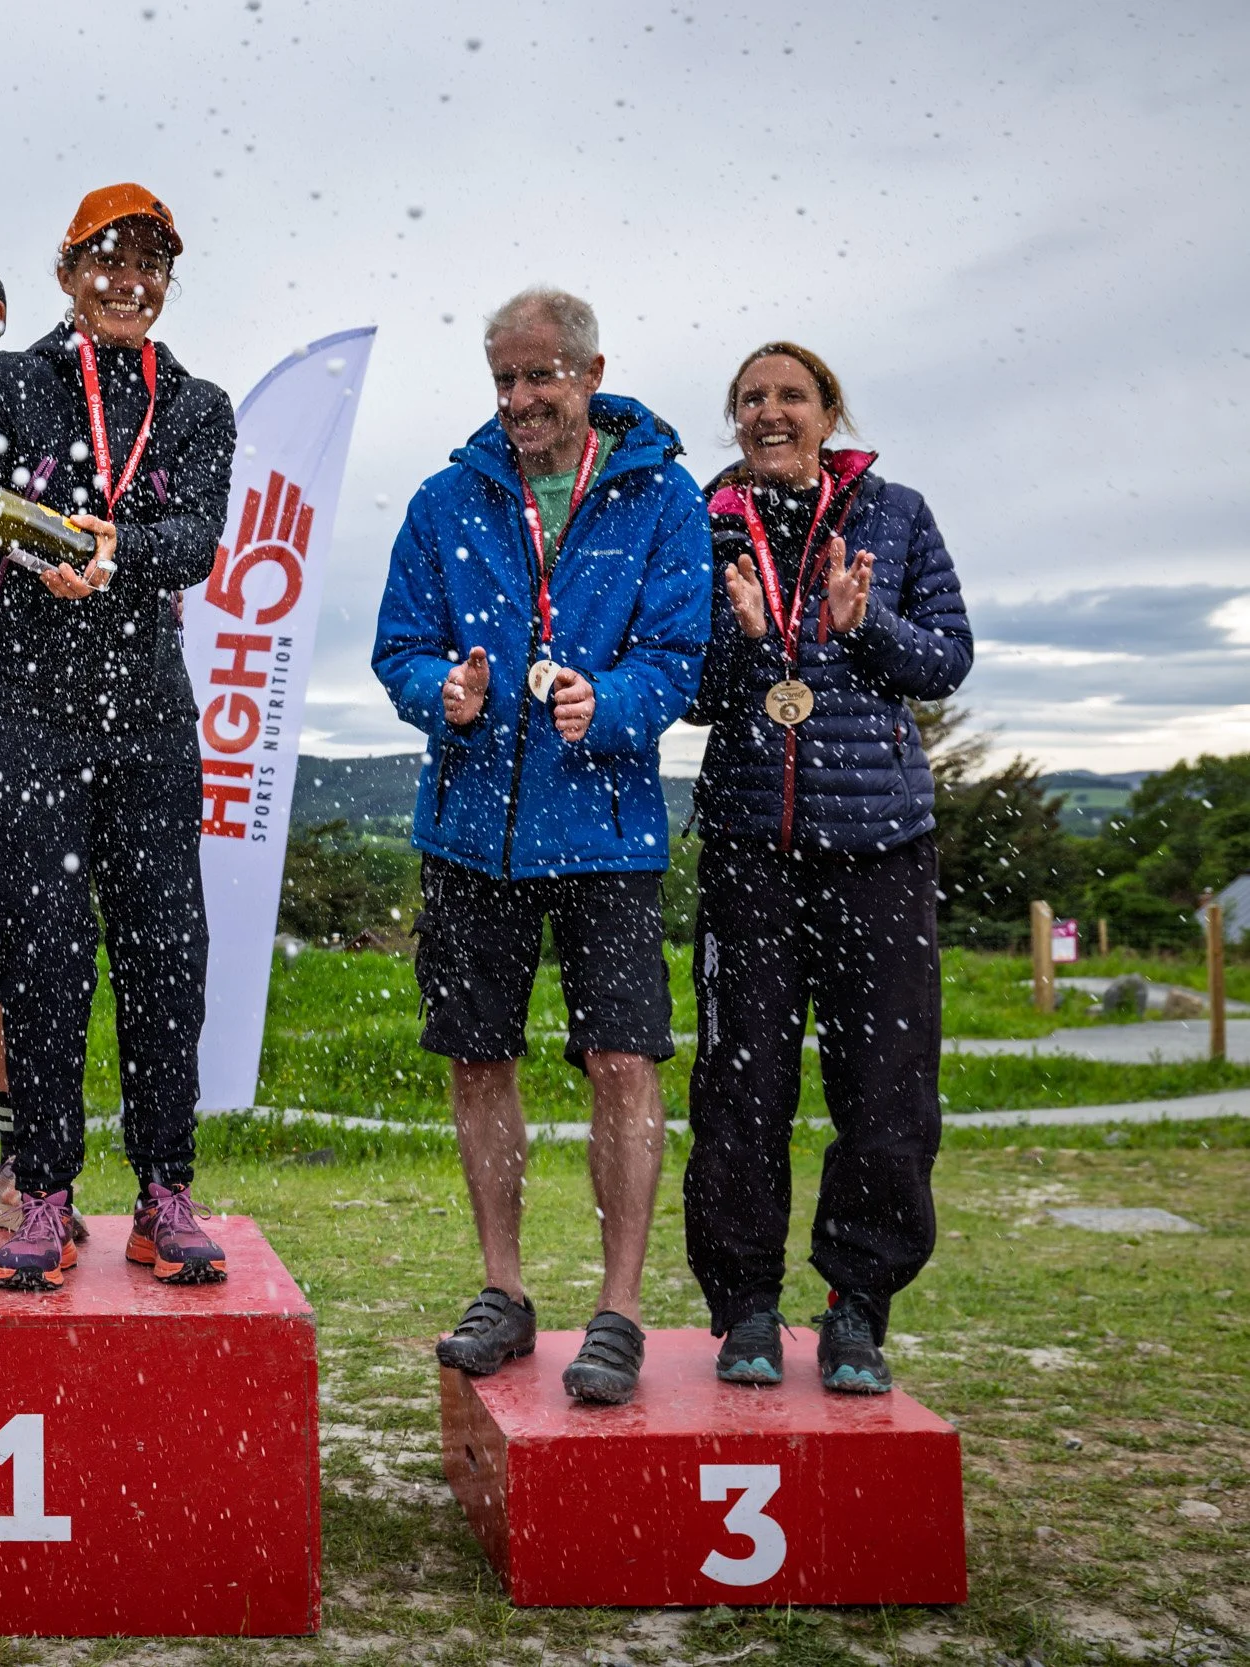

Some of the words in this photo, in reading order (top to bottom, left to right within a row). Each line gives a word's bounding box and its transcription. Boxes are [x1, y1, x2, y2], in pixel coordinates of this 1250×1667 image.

[92, 403, 105, 449] tweedlove
[98, 449, 107, 467] bike
[119, 446, 142, 492] tweedlove
[575, 447, 595, 491] tweedlove
[759, 549, 776, 591] tweedlove
[252, 766, 276, 842] SPORTS
[264, 636, 294, 751] NUTRITION
[700, 1464, 787, 1586] 3
